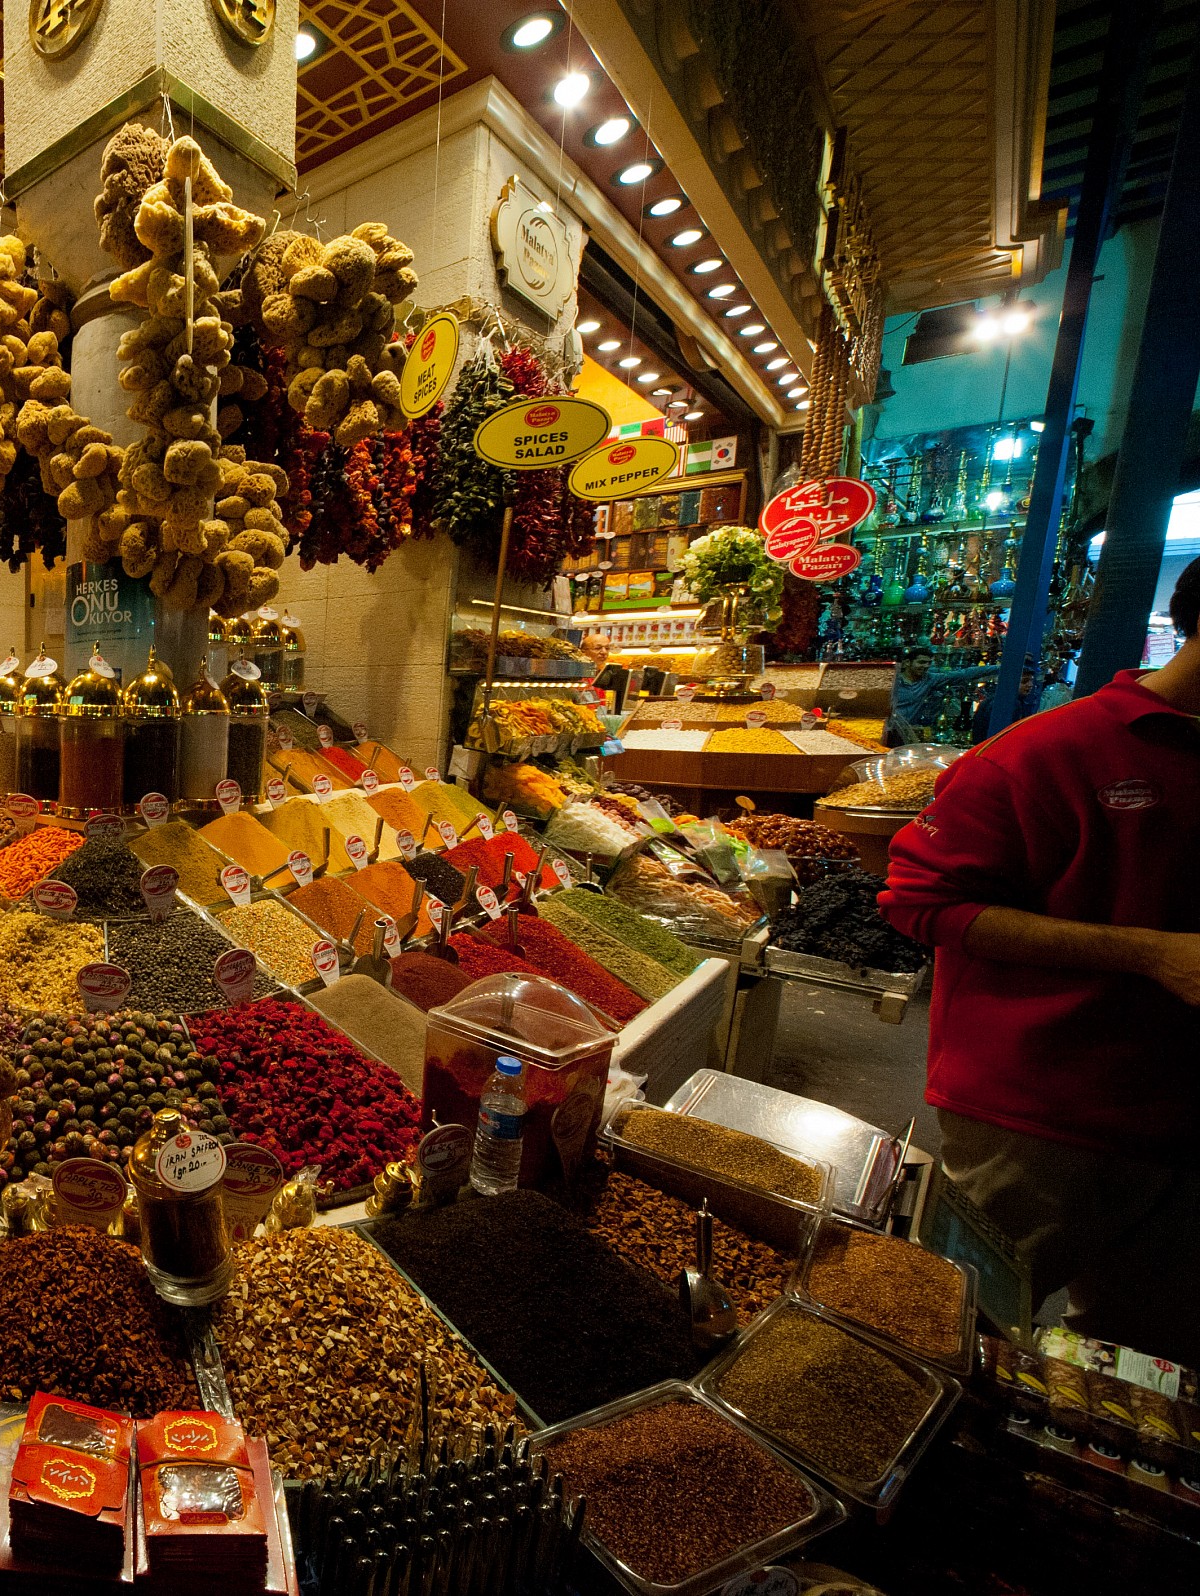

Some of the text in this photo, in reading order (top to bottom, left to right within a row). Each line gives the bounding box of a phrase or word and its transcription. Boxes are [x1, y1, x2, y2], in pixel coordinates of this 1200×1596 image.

[417, 363, 435, 387] MEAT
[413, 377, 437, 404] SPICES
[513, 431, 569, 447] SPICES
[515, 445, 565, 459] SALAD
[585, 467, 659, 491] MIX PEPPER
[798, 555, 851, 564] Malatya
[76, 579, 118, 596] HERKES
[227, 1160, 262, 1173] RANGE
[64, 1174, 98, 1187] APPLE
